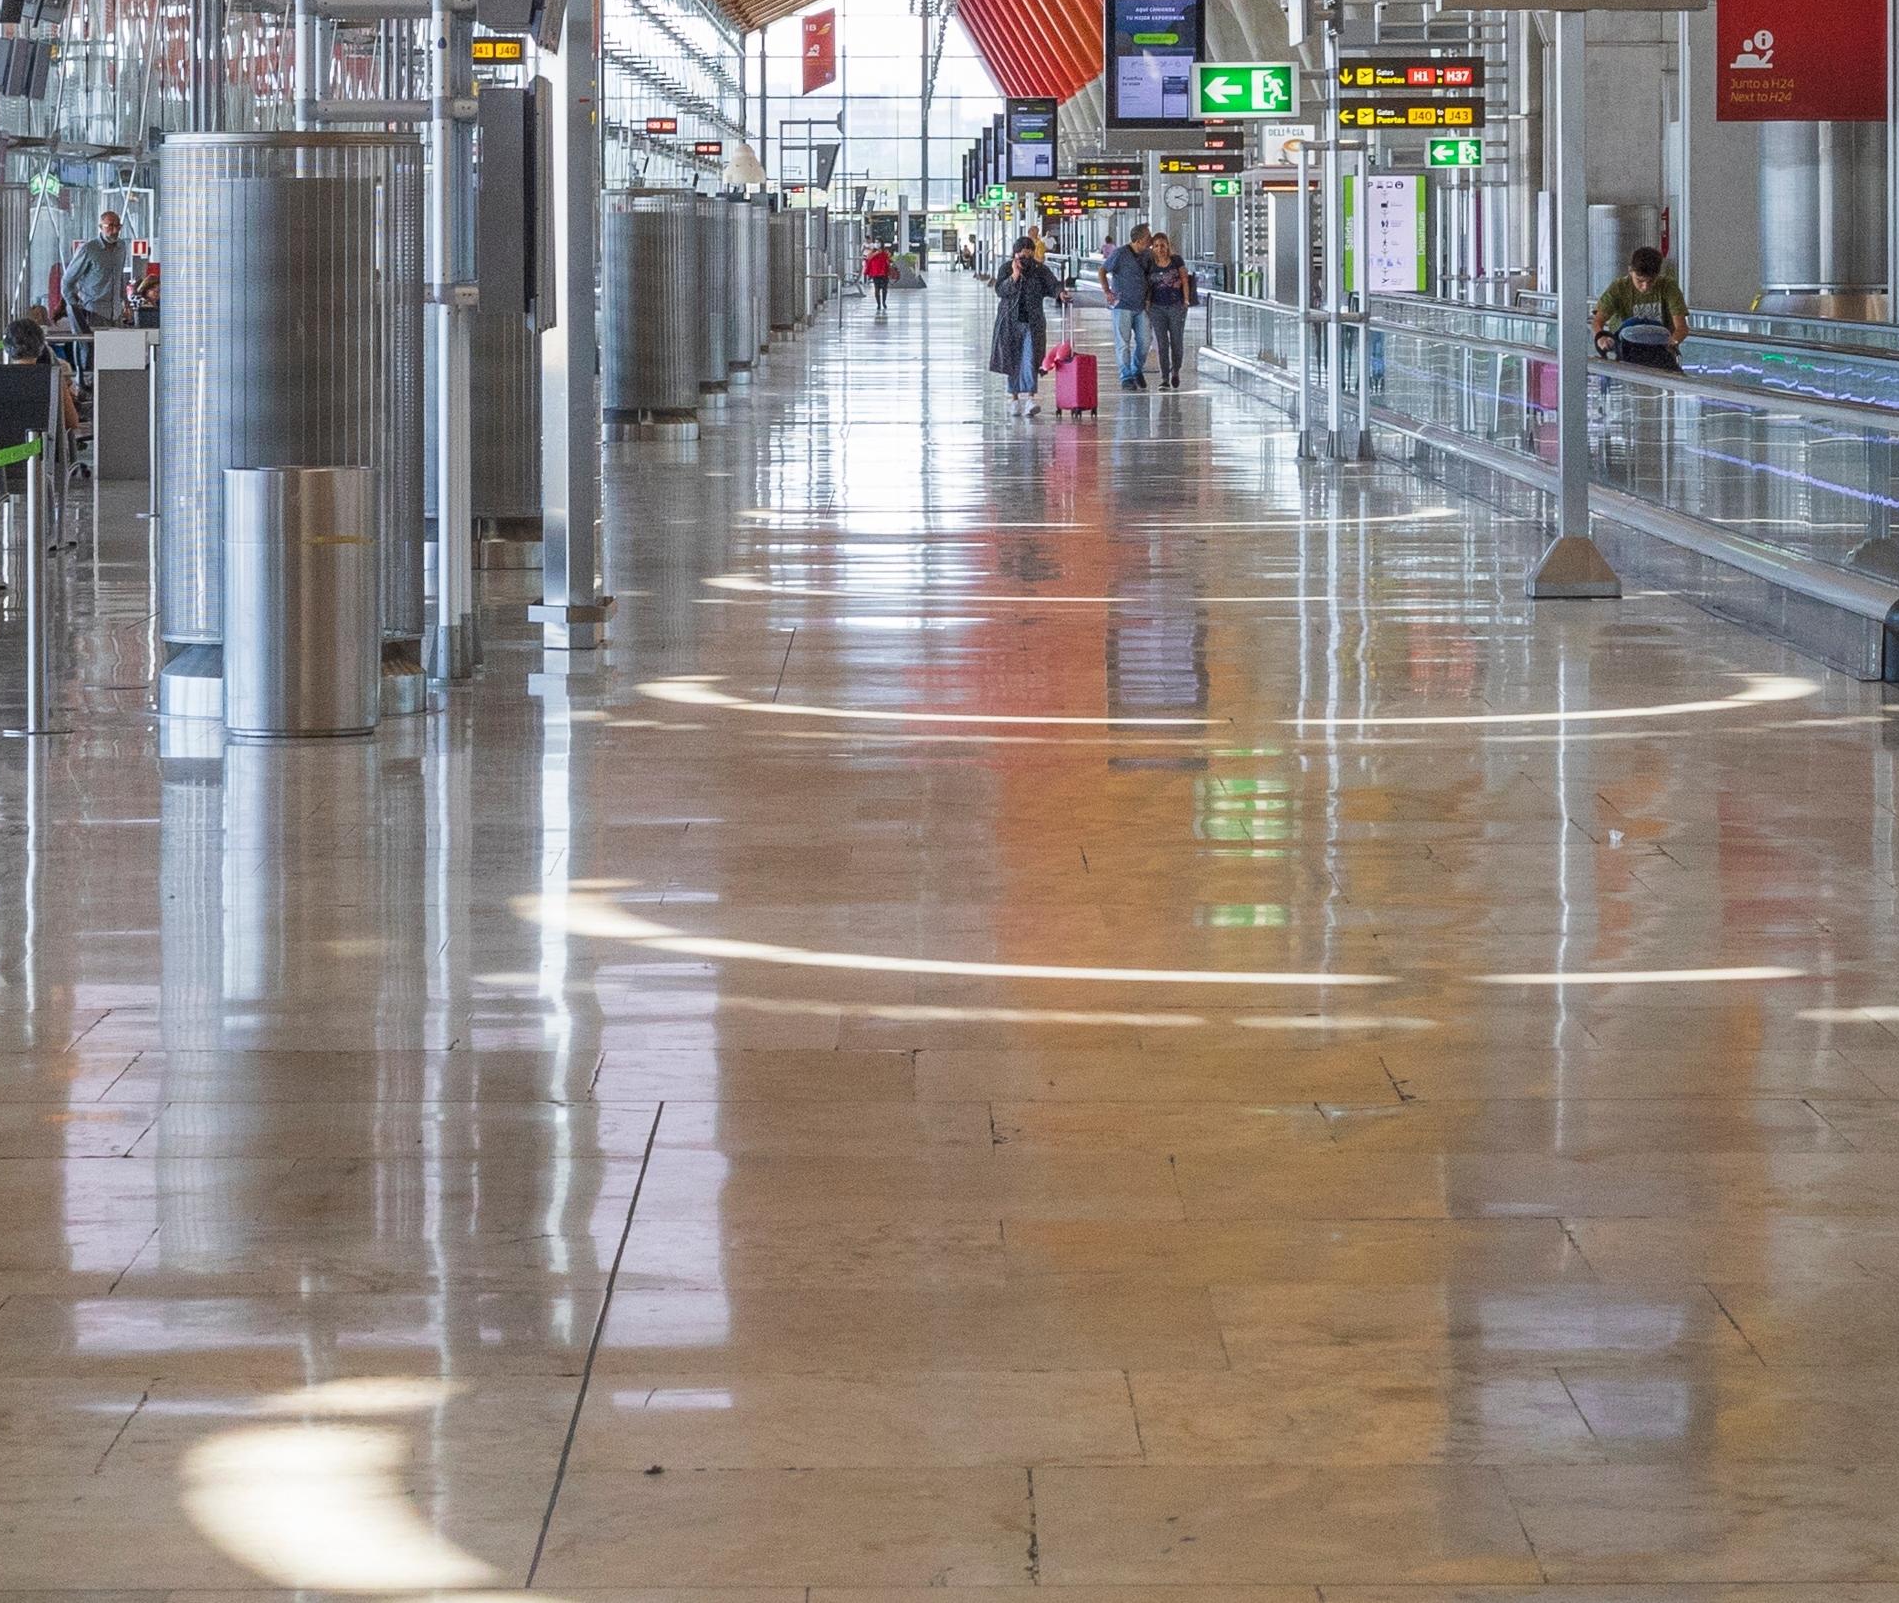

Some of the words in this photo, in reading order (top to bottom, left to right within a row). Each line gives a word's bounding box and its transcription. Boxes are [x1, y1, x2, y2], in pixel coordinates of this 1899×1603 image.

[499, 44, 518, 55] J40
[1413, 71, 1429, 81] H1
[1446, 71, 1469, 82] H37
[1730, 78, 1760, 89] Junto
[1763, 80, 1770, 89] a
[1771, 79, 1795, 89] H24
[1730, 92, 1755, 102] Next
[1757, 93, 1768, 102] to
[1769, 92, 1792, 102] H24
[1412, 111, 1432, 121] J40
[1449, 111, 1469, 121] J43
[1345, 216, 1354, 251] Salidas
